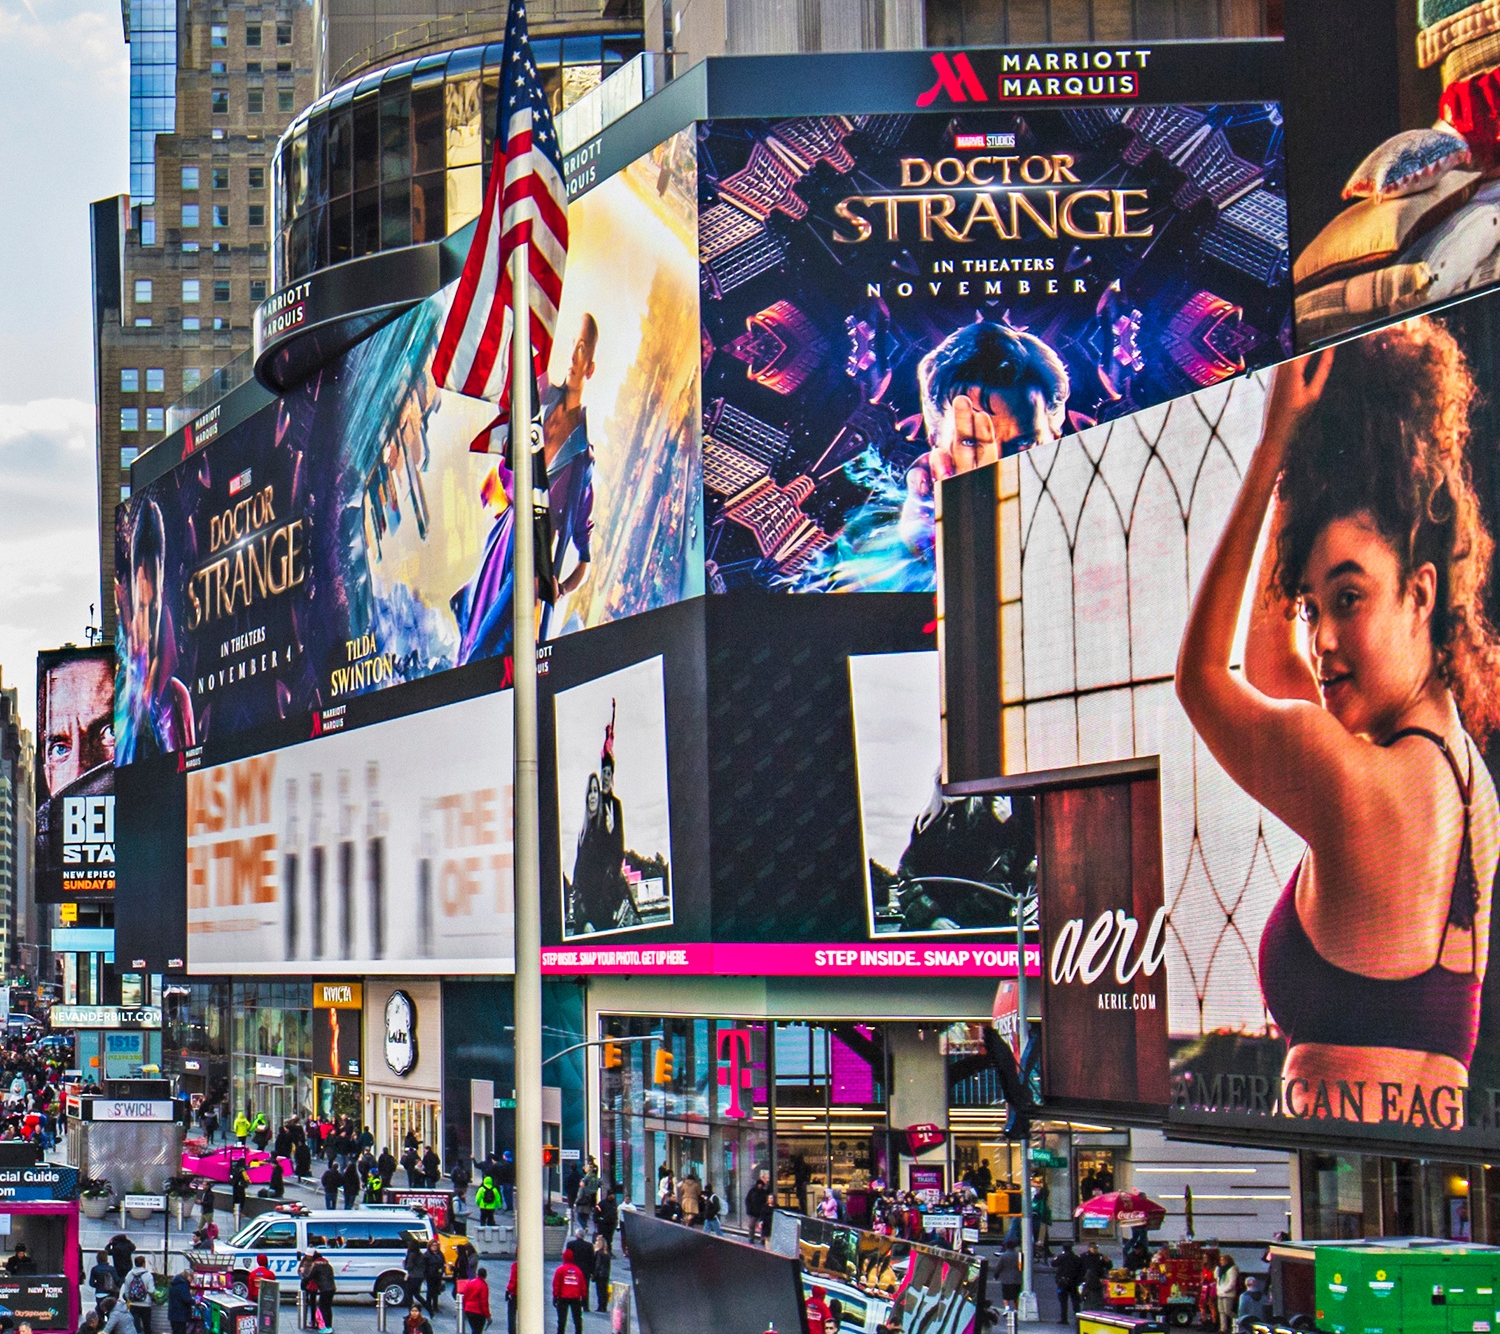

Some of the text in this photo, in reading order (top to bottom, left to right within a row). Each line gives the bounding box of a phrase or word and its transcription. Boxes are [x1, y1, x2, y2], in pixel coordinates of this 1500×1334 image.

[1002, 51, 1151, 71] MARRIOTT
[1003, 75, 1134, 96] MARQUIS
[956, 133, 1015, 148] MARVEL STUDIOS
[900, 154, 1081, 187] DOCTOR
[832, 188, 1154, 243] STRANGE
[933, 258, 1055, 273] IN THEATERS
[867, 278, 1122, 298] NOVEMBER 4
[210, 484, 276, 550] DOCTOR
[187, 520, 304, 631] STRANGE
[231, 627, 266, 654] THEATERS
[346, 635, 376, 661] TILDA
[198, 655, 278, 694] NOVEMBER
[331, 653, 393, 696] SWINTON
[63, 871, 84, 879] NEW
[63, 879, 106, 890] SUNDAY
[815, 950, 970, 967] STEP INSIDE. SNAP
[1098, 993, 1157, 1010] AERIE.COM
[107, 1035, 140, 1052] 1515
[23, 1171, 60, 1182] Guide
